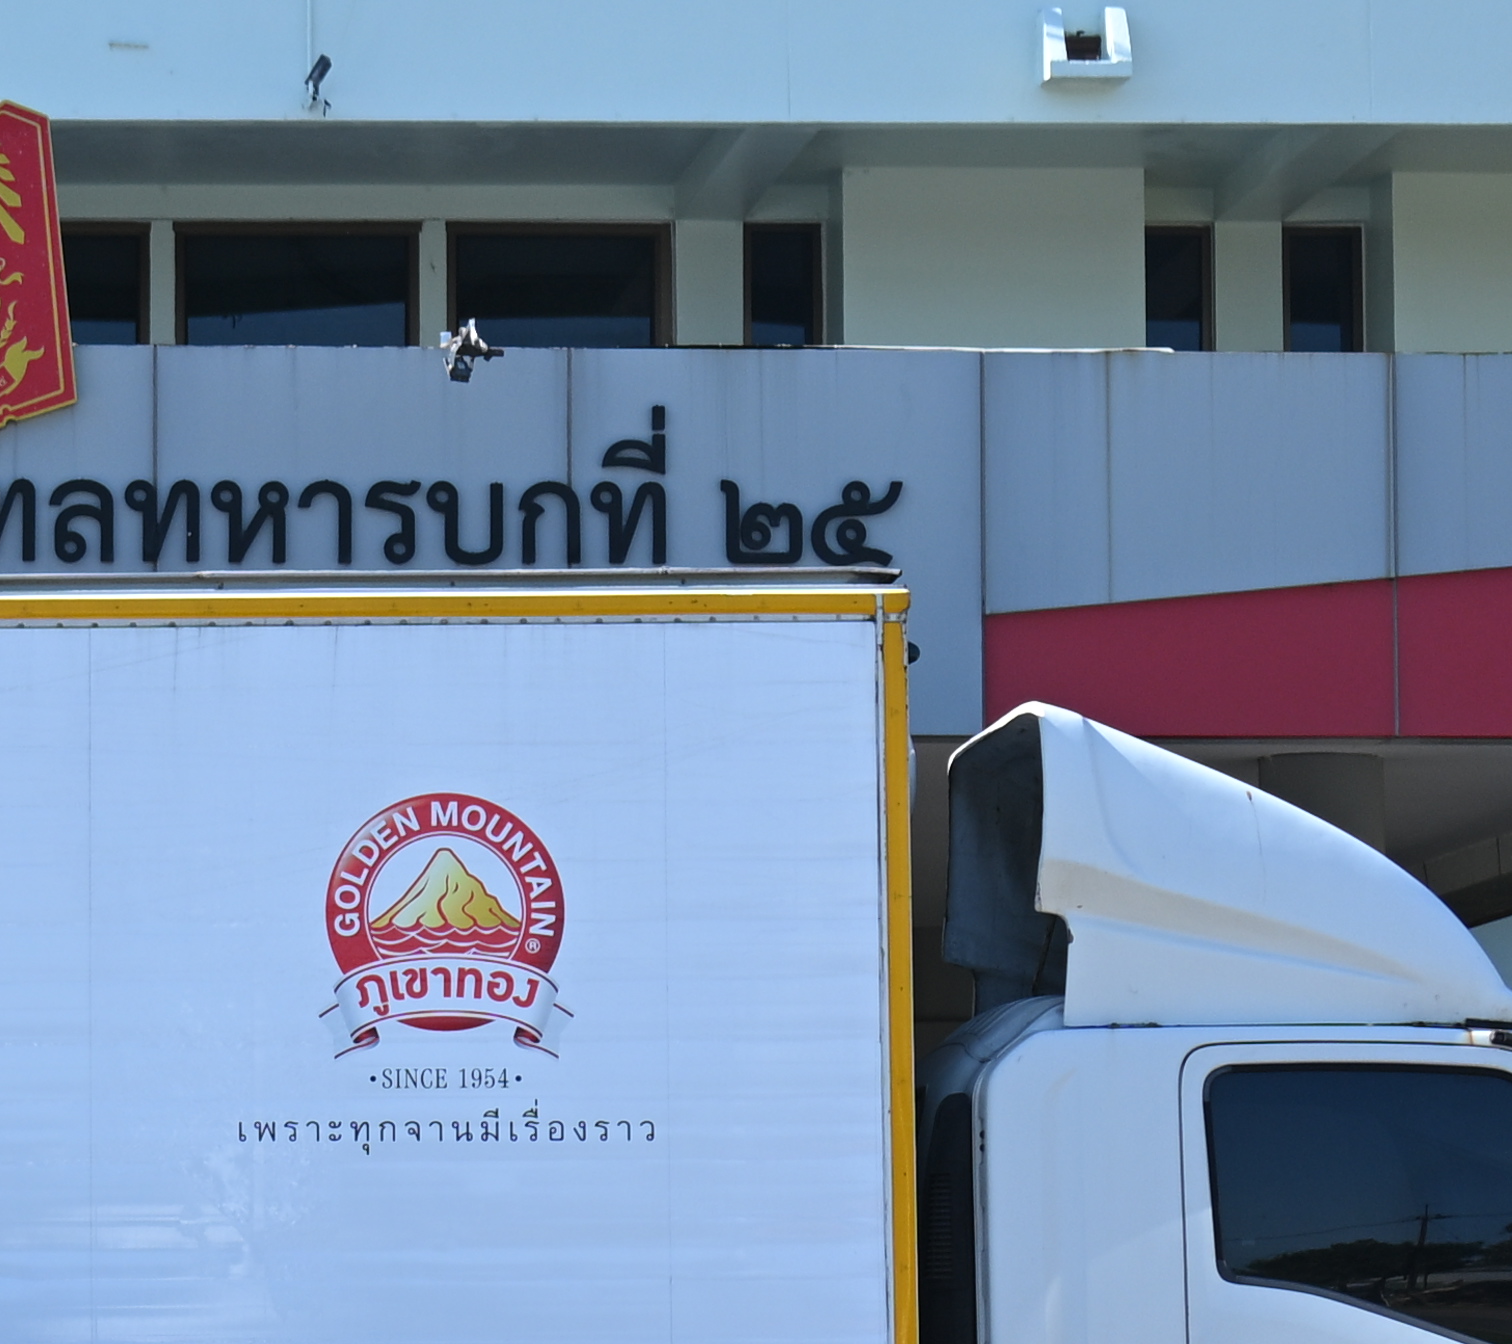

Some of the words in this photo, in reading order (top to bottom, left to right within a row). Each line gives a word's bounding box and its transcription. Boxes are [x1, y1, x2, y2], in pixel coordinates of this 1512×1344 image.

[720, 478, 905, 568] ๒๕
[333, 806, 421, 937] GOLDEN
[430, 800, 557, 937] MOUNTAIN
[355, 966, 540, 1016] ภูเขาทอง
[381, 1067, 448, 1089] SINCE
[459, 1067, 510, 1089] 1954
[237, 1099, 657, 1155] เพราะทุกจานมีเรื่องราว
